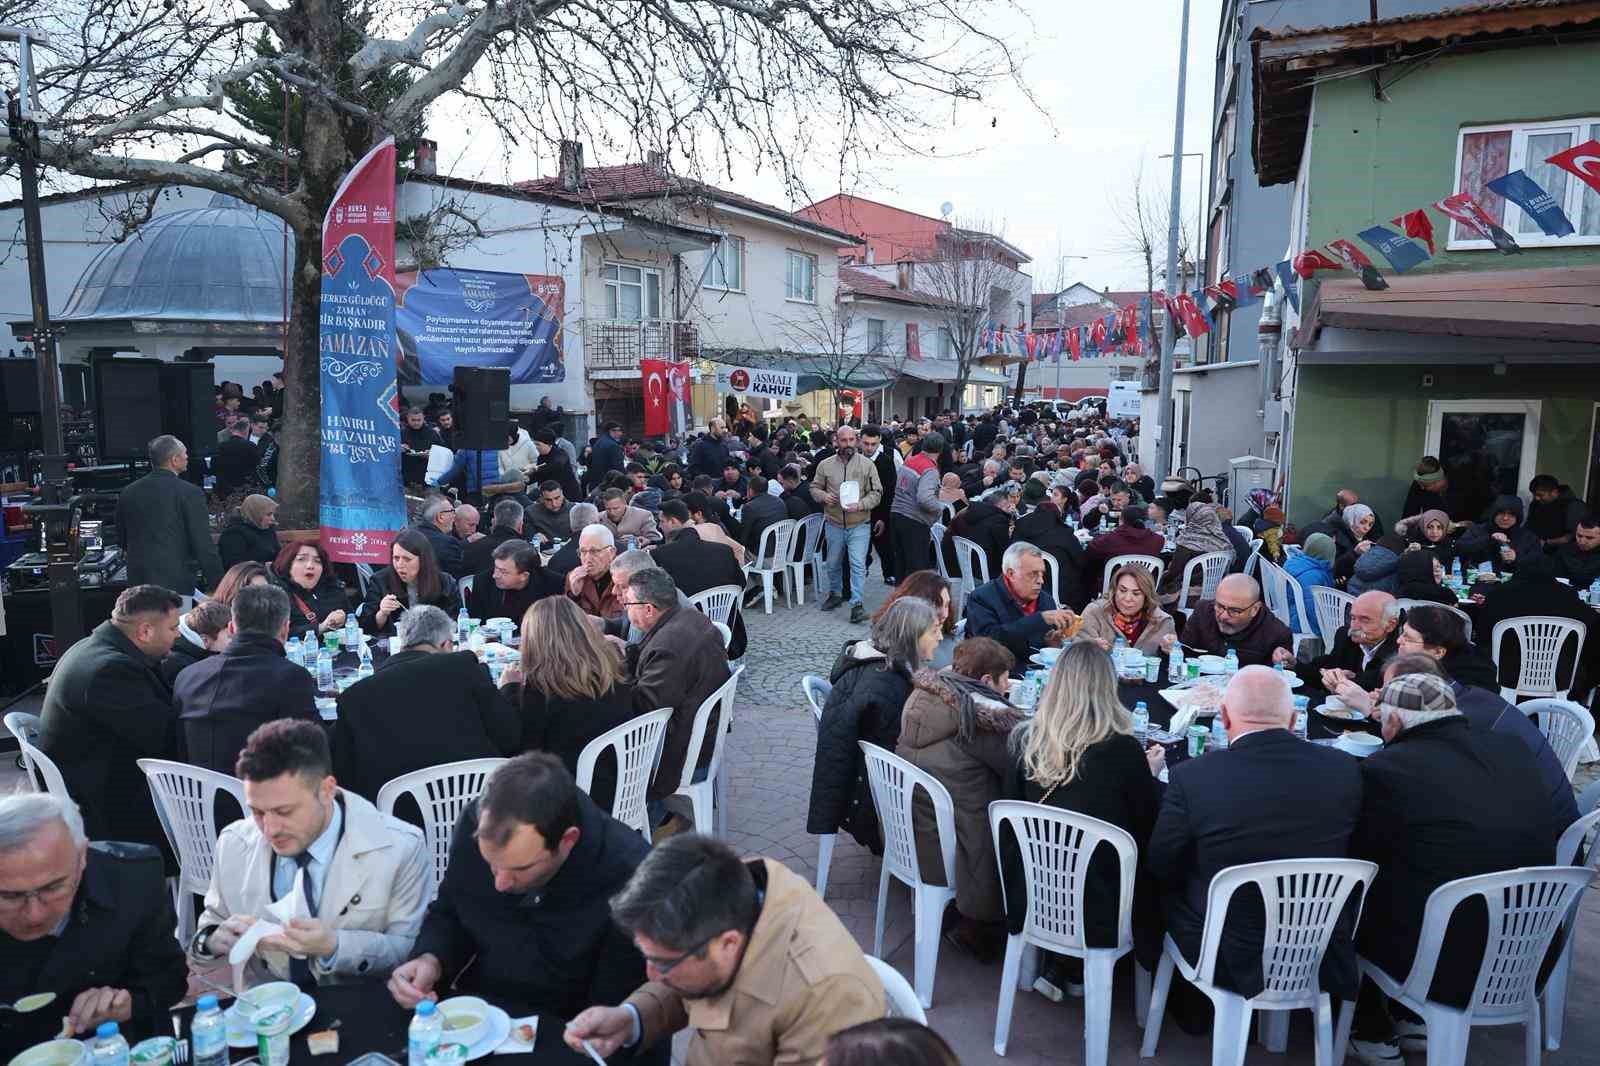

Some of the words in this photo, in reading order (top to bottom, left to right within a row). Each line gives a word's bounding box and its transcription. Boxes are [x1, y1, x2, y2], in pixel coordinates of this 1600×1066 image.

[337, 306, 367, 317] ZAMAN
[335, 316, 386, 330] BAŞKADIR
[754, 373, 792, 386] ASMALI
[753, 382, 792, 397] KAHVE
[321, 429, 396, 453] AMAZANLAR
